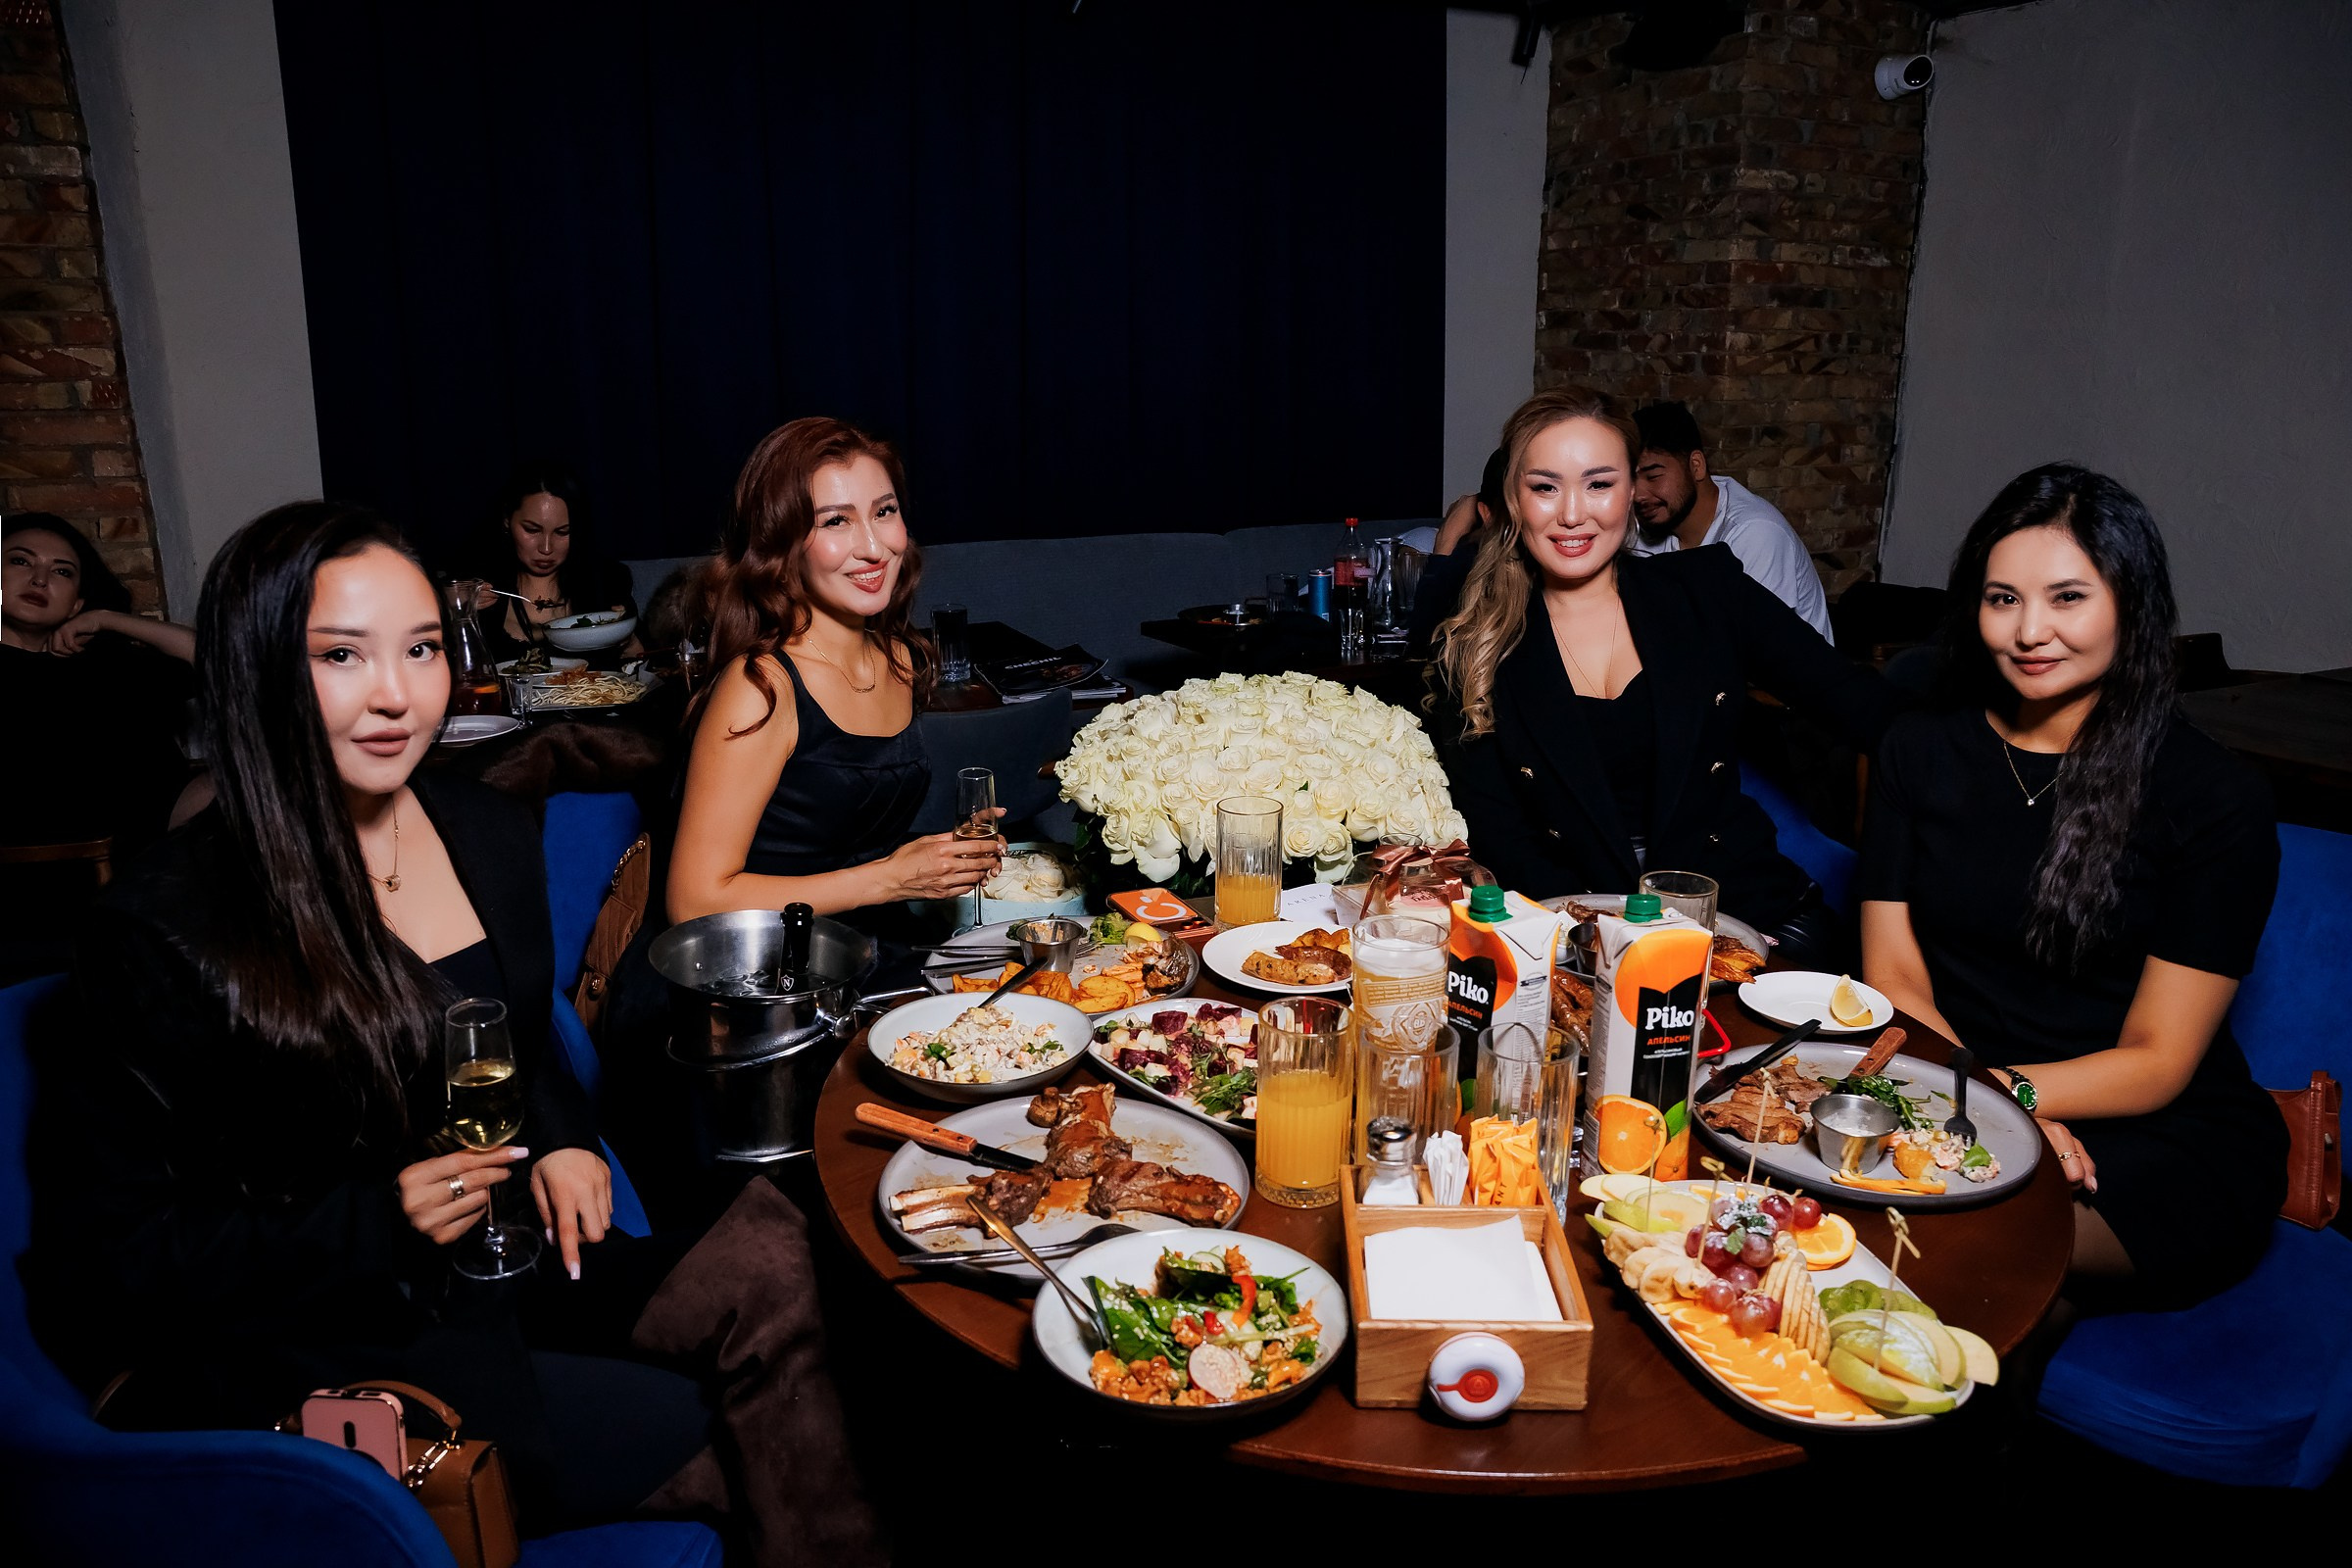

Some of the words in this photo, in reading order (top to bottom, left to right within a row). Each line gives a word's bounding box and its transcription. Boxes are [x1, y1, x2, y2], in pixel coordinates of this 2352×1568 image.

[1447, 970, 1489, 1004] Piko
[1645, 1005, 1694, 1030] Piko
[1646, 1035, 1690, 1046] АПЕЛЬСИН
